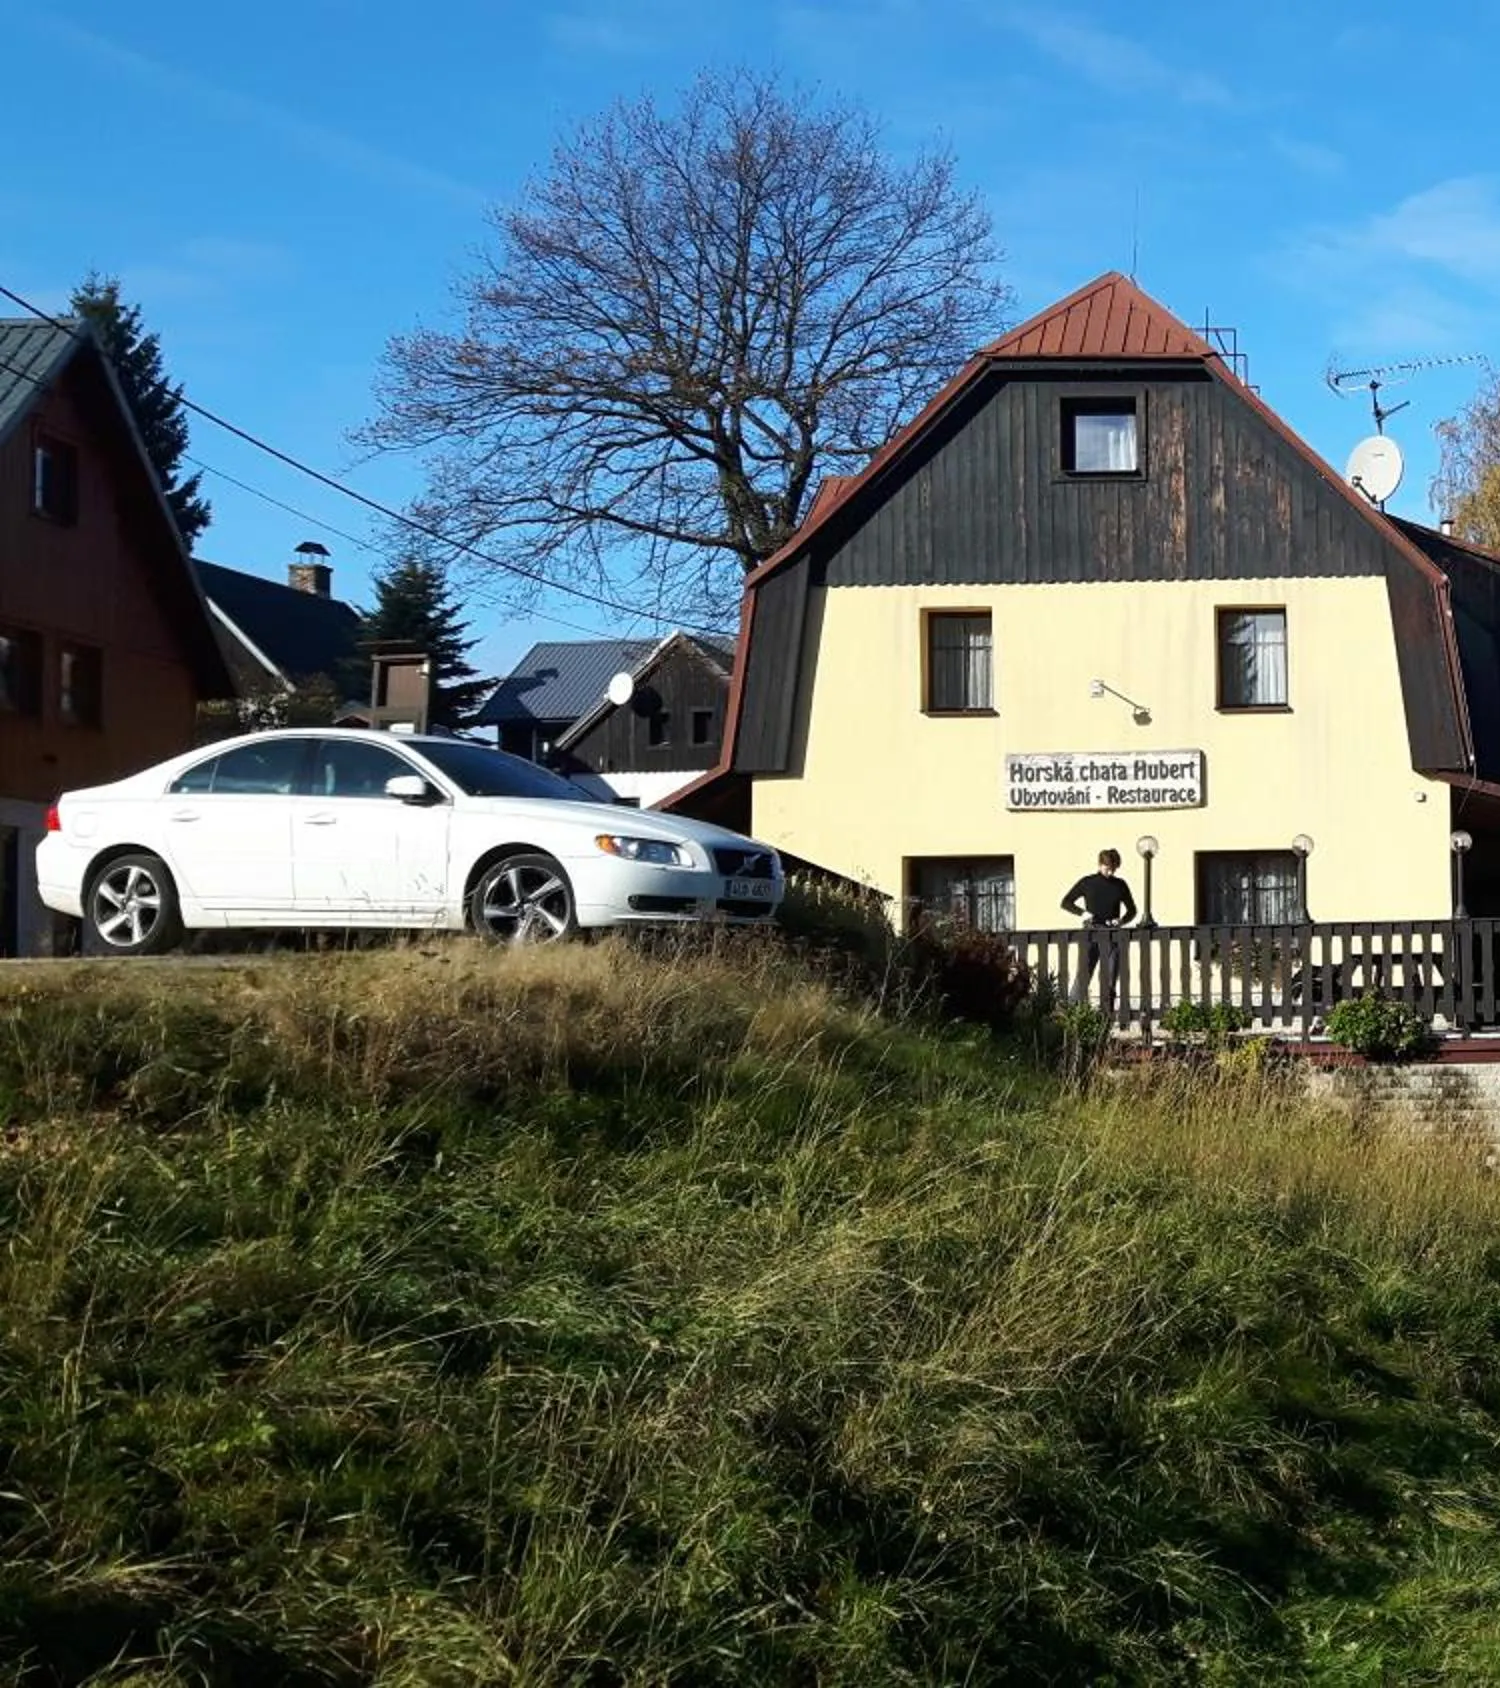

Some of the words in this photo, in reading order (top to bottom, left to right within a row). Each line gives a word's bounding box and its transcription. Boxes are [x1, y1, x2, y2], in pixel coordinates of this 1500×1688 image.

[1009, 762, 1073, 782] Horská
[1079, 761, 1127, 780] chata
[1133, 760, 1195, 780] Hubert
[1009, 786, 1090, 806] Ubytování
[1107, 785, 1196, 804] Restaurace
